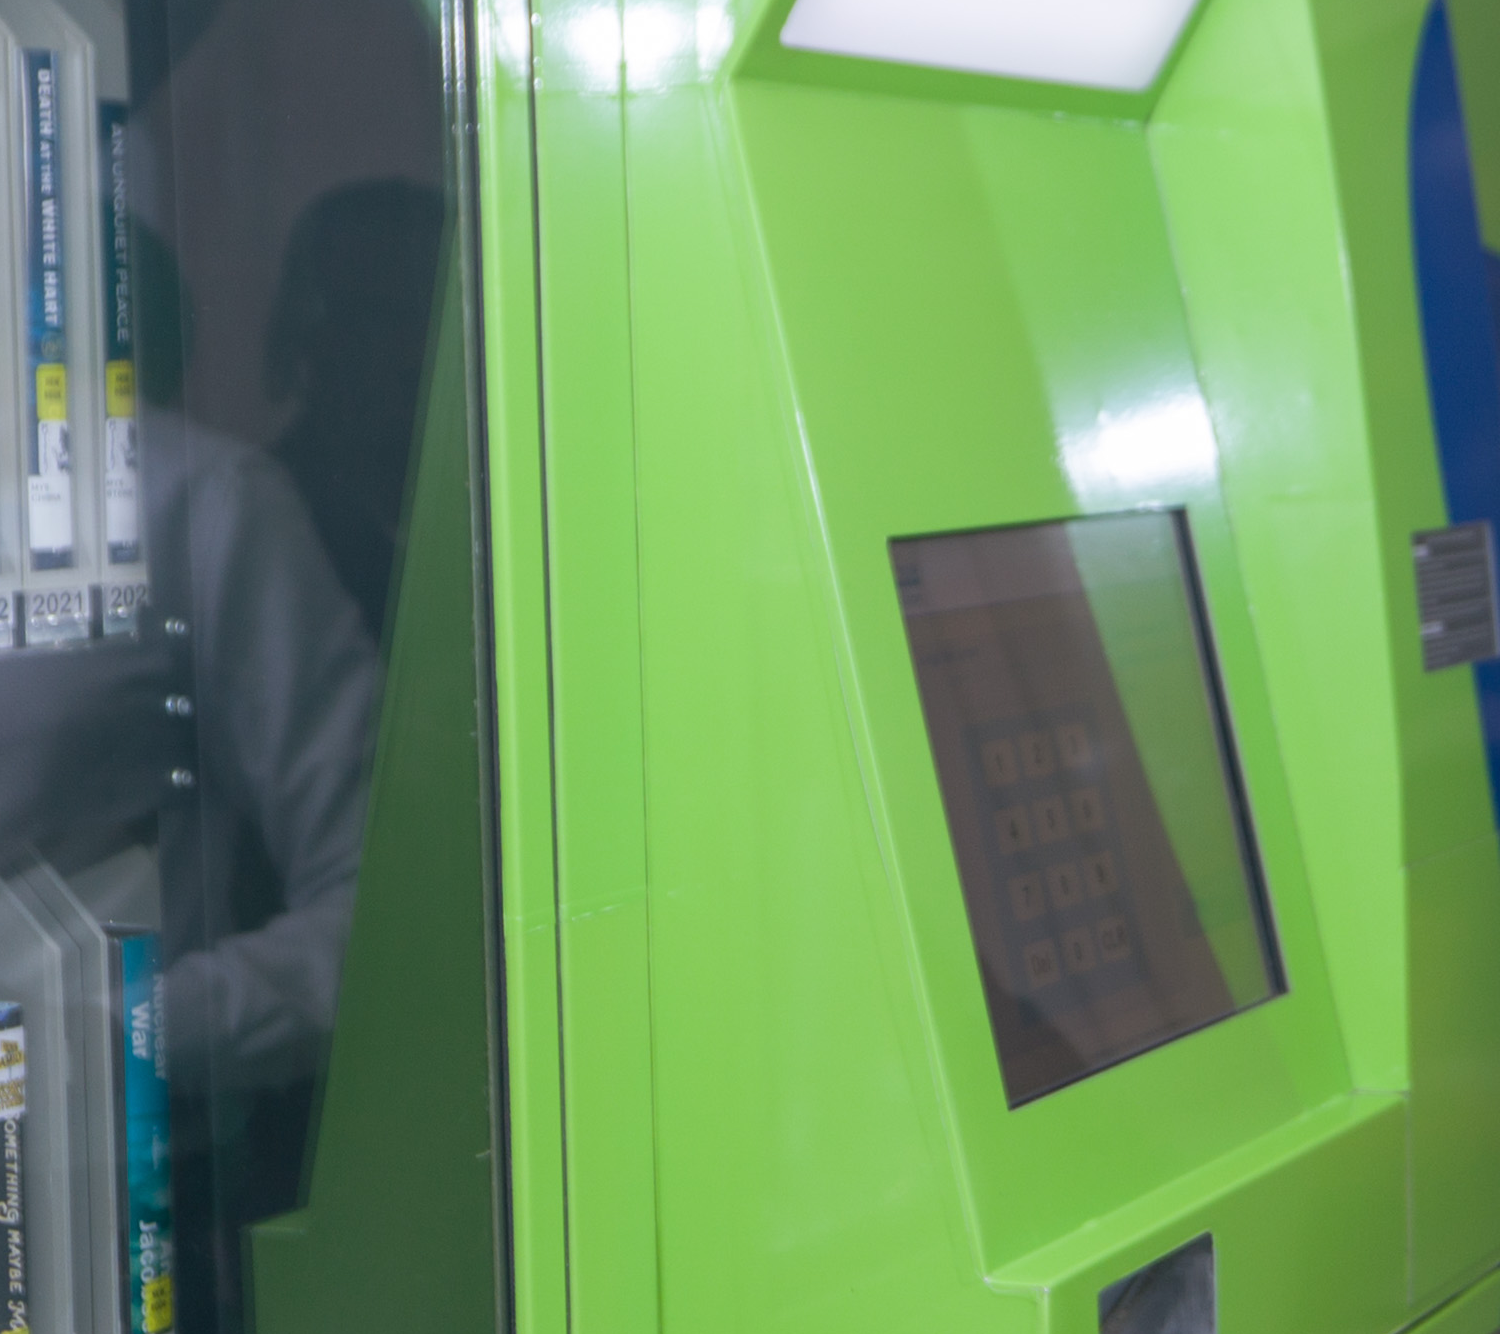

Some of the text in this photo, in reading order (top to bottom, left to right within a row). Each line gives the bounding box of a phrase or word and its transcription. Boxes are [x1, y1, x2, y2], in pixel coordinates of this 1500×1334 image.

[33, 592, 83, 616] 2021
[131, 1002, 150, 1060] War
[7, 1227, 24, 1294] MAYBE
